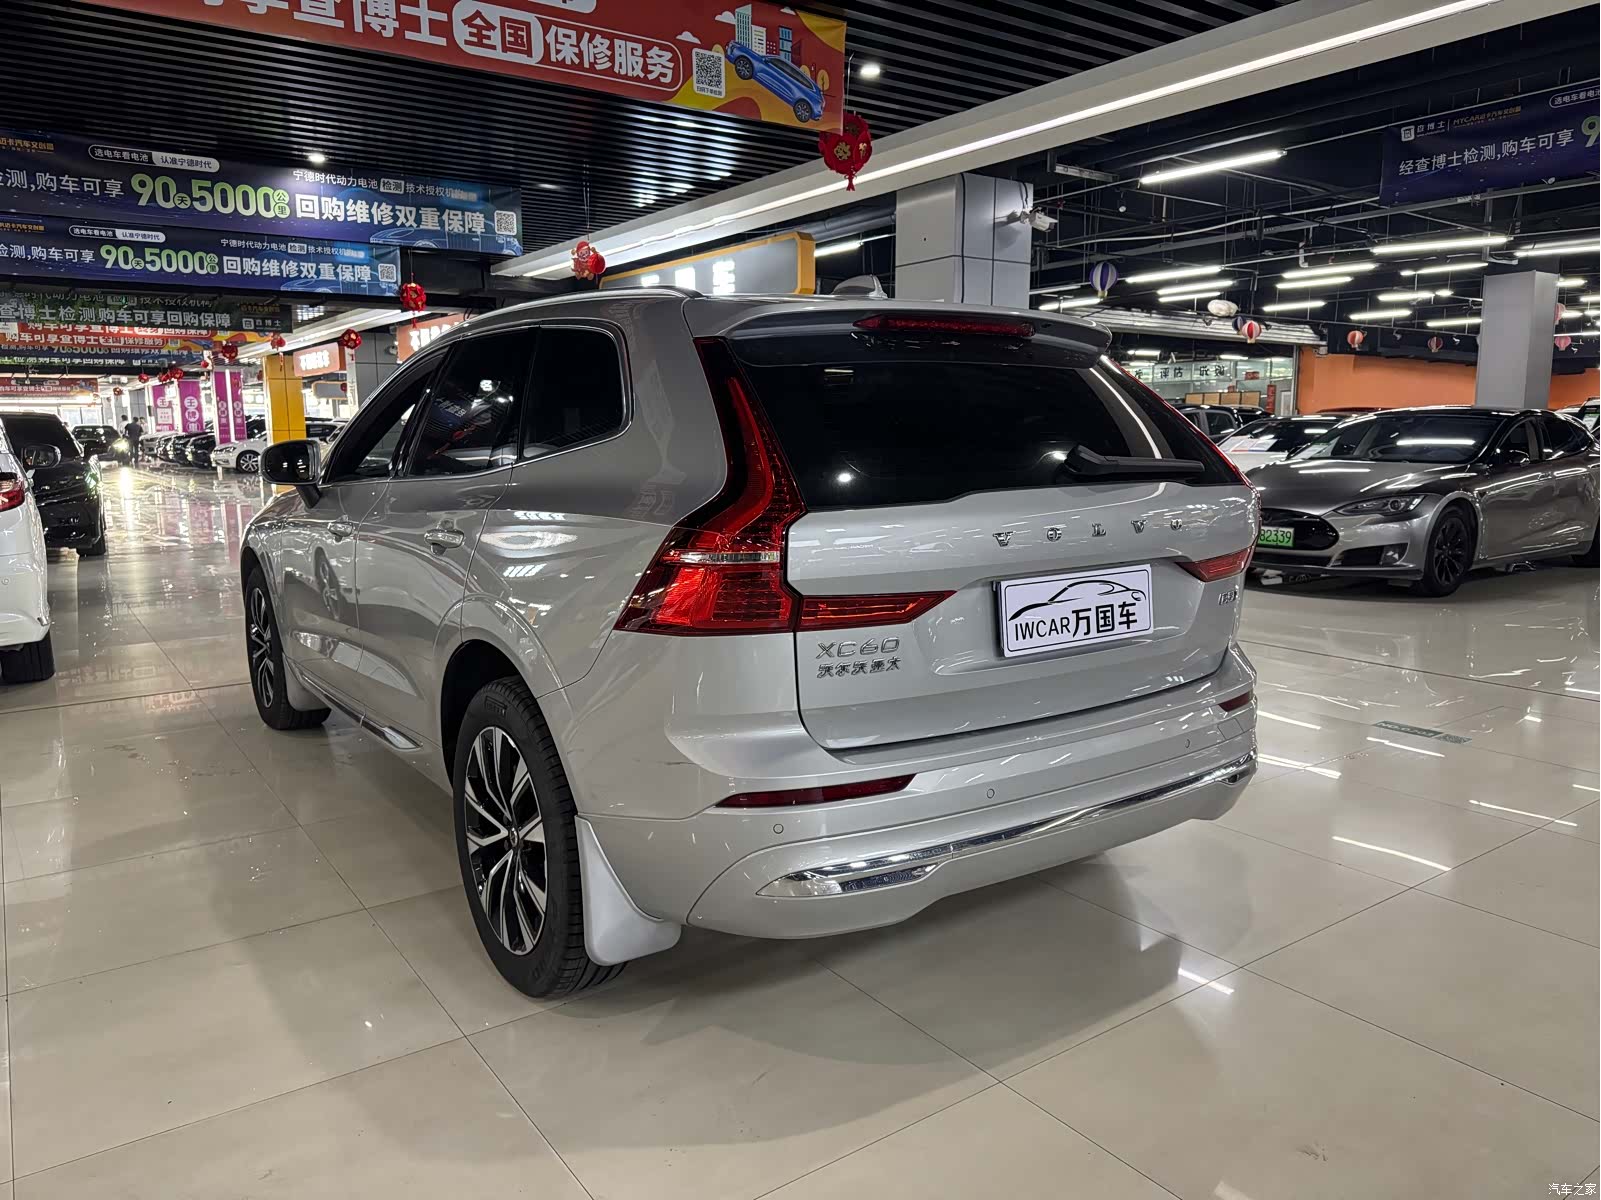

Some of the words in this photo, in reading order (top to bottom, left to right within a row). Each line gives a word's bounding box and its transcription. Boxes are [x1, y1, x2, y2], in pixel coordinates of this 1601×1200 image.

[460, 10, 533, 59] 全国
[545, 24, 675, 84] 保修服务
[94, 149, 149, 162] 选电车看电池
[160, 155, 212, 169] 认准宁德时代
[293, 170, 378, 188] 宁德时代动力电池
[0, 168, 124, 198] 测,购车可享
[295, 193, 486, 234] 回购维修双重保障
[73, 228, 114, 237] 选电车看电池
[221, 239, 286, 251] 宁德时代动力电池
[223, 256, 372, 282] 回购维修双重保障
[993, 518, 1182, 547] VOLVO
[1259, 529, 1292, 544] 82339
[1015, 601, 1138, 641] IWCAR万国车
[816, 637, 900, 659] XC60
[816, 656, 901, 679] 沃尔沃亚太
